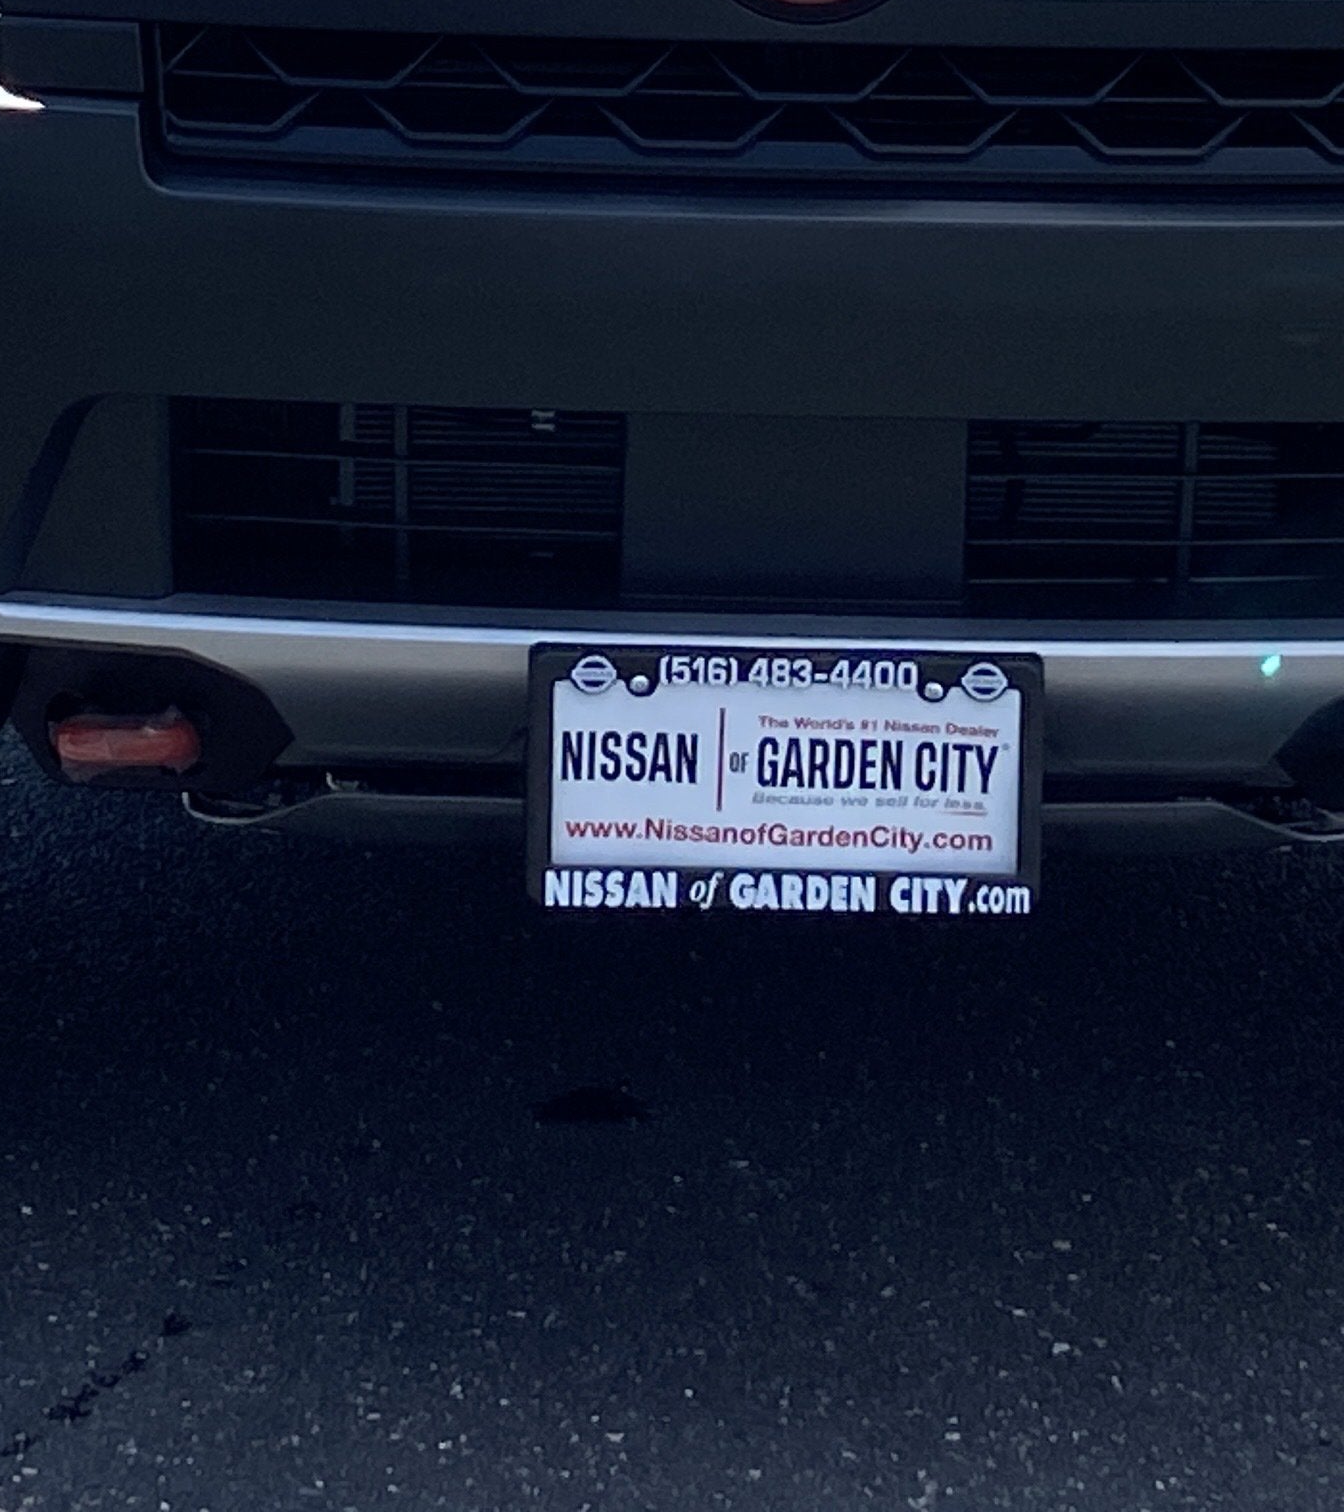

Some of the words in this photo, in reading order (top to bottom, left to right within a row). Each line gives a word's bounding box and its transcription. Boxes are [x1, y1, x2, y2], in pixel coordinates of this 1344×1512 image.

[658, 654, 739, 686] (516)
[748, 658, 919, 689] 483-4400
[758, 714, 789, 729] The
[884, 719, 940, 735] Nissan
[945, 722, 999, 738] Dealer
[560, 730, 699, 785] NISSAN
[729, 751, 749, 774] OF
[756, 736, 904, 791] GARDEN
[914, 741, 999, 795] CITY
[751, 792, 834, 807] Because
[840, 795, 869, 808] we
[874, 794, 909, 808] sell
[913, 795, 939, 809] for
[564, 817, 993, 854] www.NissanofGardenCity.com
[544, 869, 678, 909] NISSAN
[689, 871, 725, 912] of
[728, 872, 877, 913] GARDEN
[889, 876, 1032, 914] CITY.com
